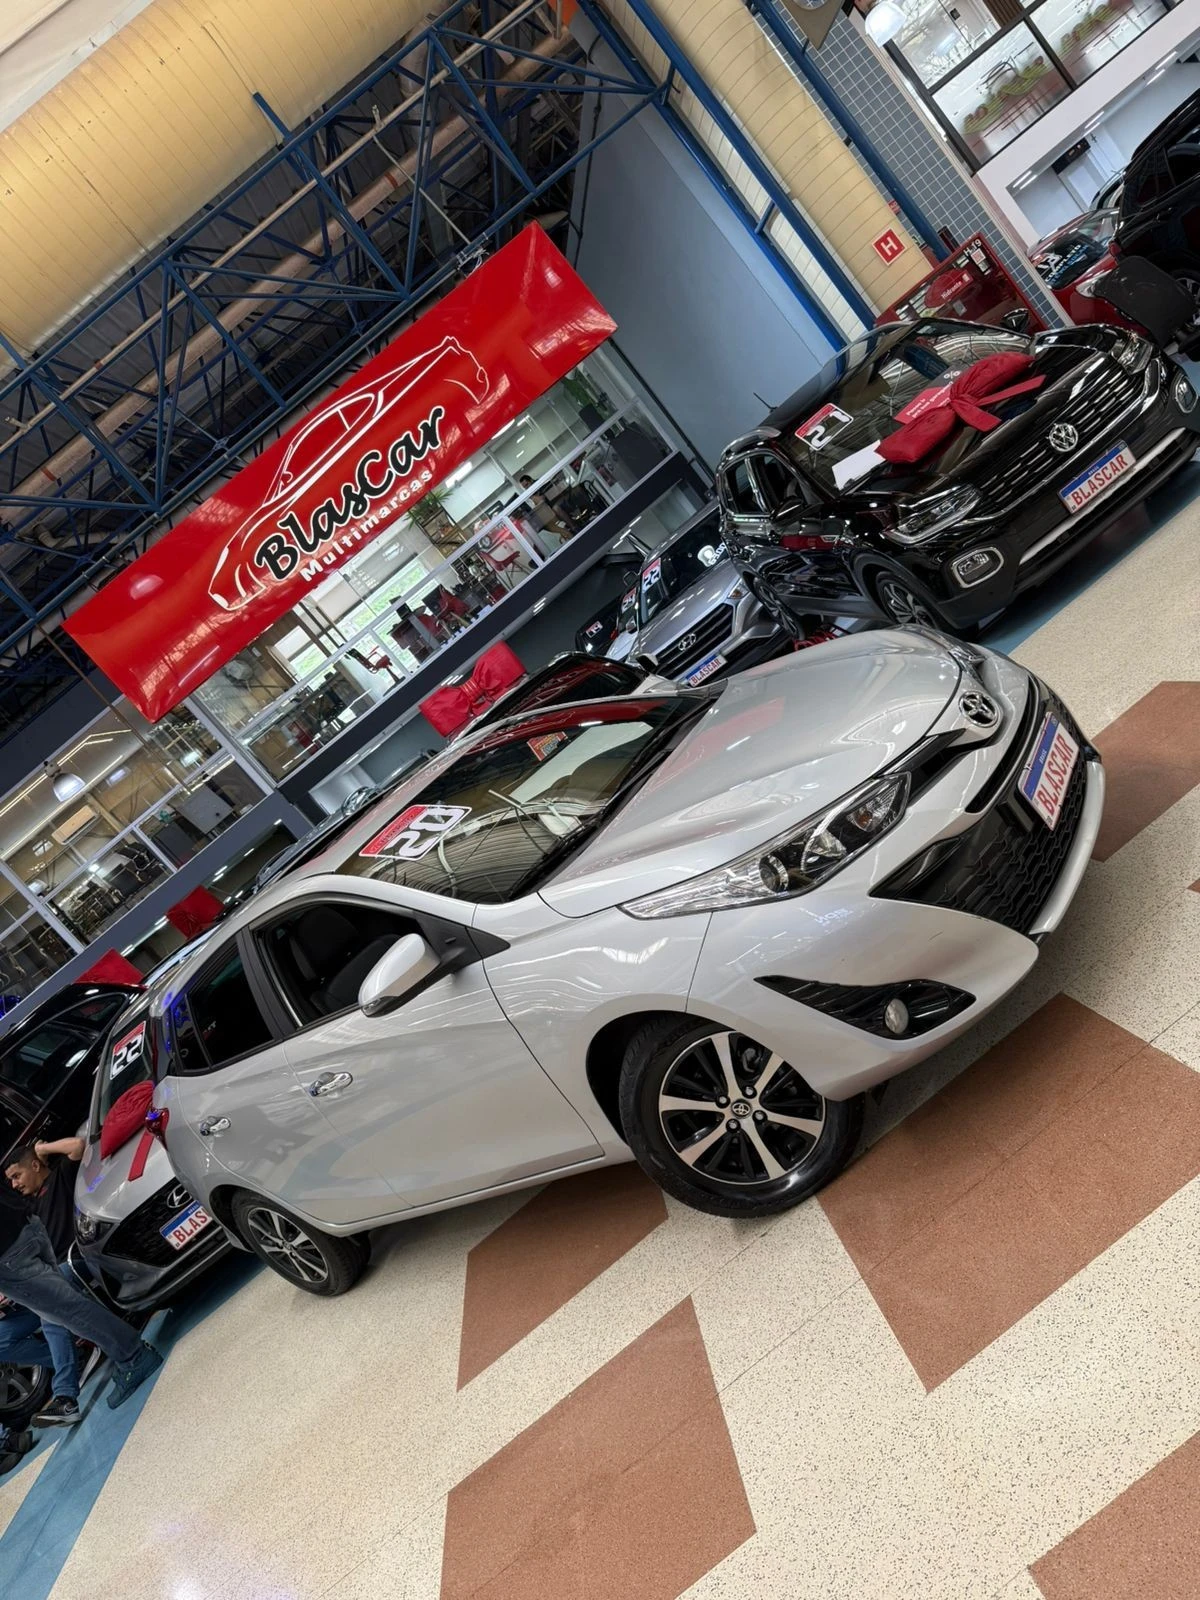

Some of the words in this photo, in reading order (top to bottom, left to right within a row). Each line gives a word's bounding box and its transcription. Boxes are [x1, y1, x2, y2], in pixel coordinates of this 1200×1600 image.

[880, 236, 898, 256] H
[1045, 244, 1081, 282] COMPLETO
[941, 280, 962, 299] Hidrante
[806, 411, 850, 447] 21
[254, 406, 445, 581] BlasCar
[1071, 454, 1128, 506] BLASCAR
[299, 469, 433, 582] Multimarcas
[643, 568, 661, 592] 22
[691, 658, 721, 684] BLASCAR
[1037, 733, 1074, 816] BLASCAR
[384, 808, 465, 857] 20
[112, 1034, 142, 1075] 22
[173, 1208, 209, 1243] BLAS
